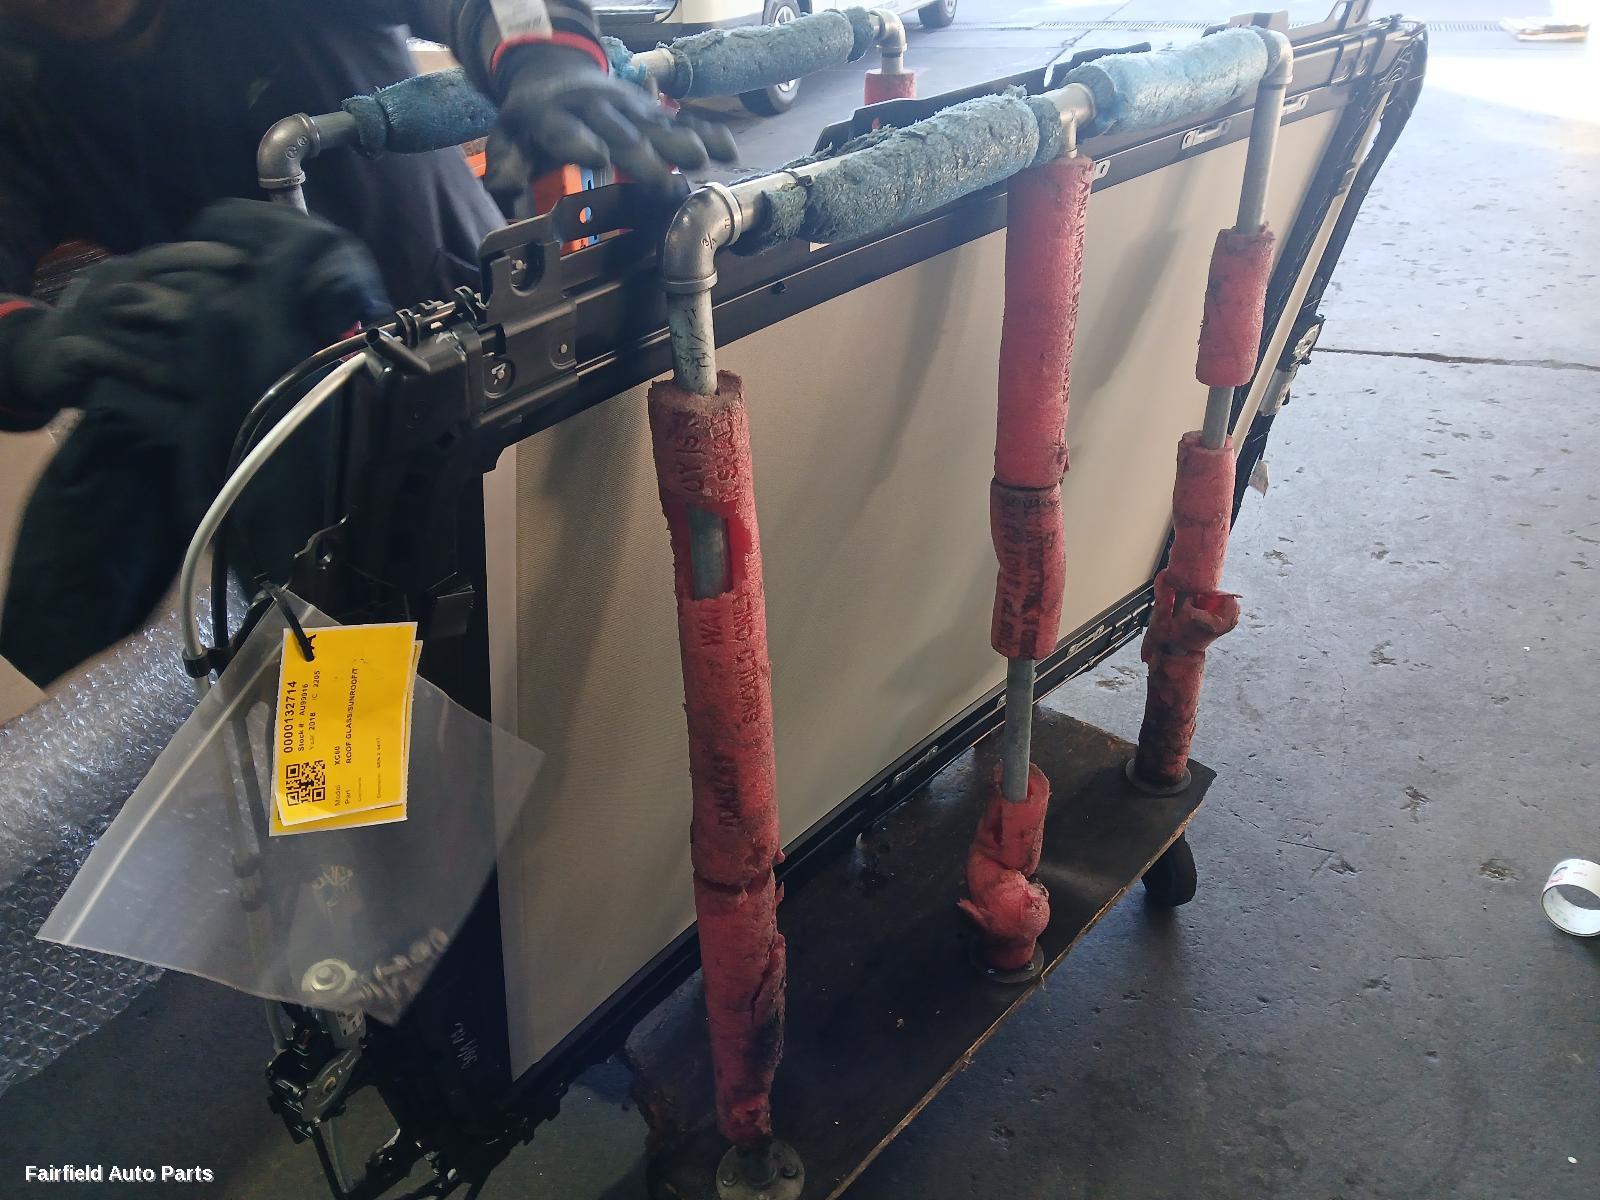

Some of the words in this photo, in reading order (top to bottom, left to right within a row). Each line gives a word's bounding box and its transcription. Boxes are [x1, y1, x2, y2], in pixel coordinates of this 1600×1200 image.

[283, 680, 297, 754] 0000132714
[308, 712, 316, 731] 2018
[297, 729, 305, 752] Stock
